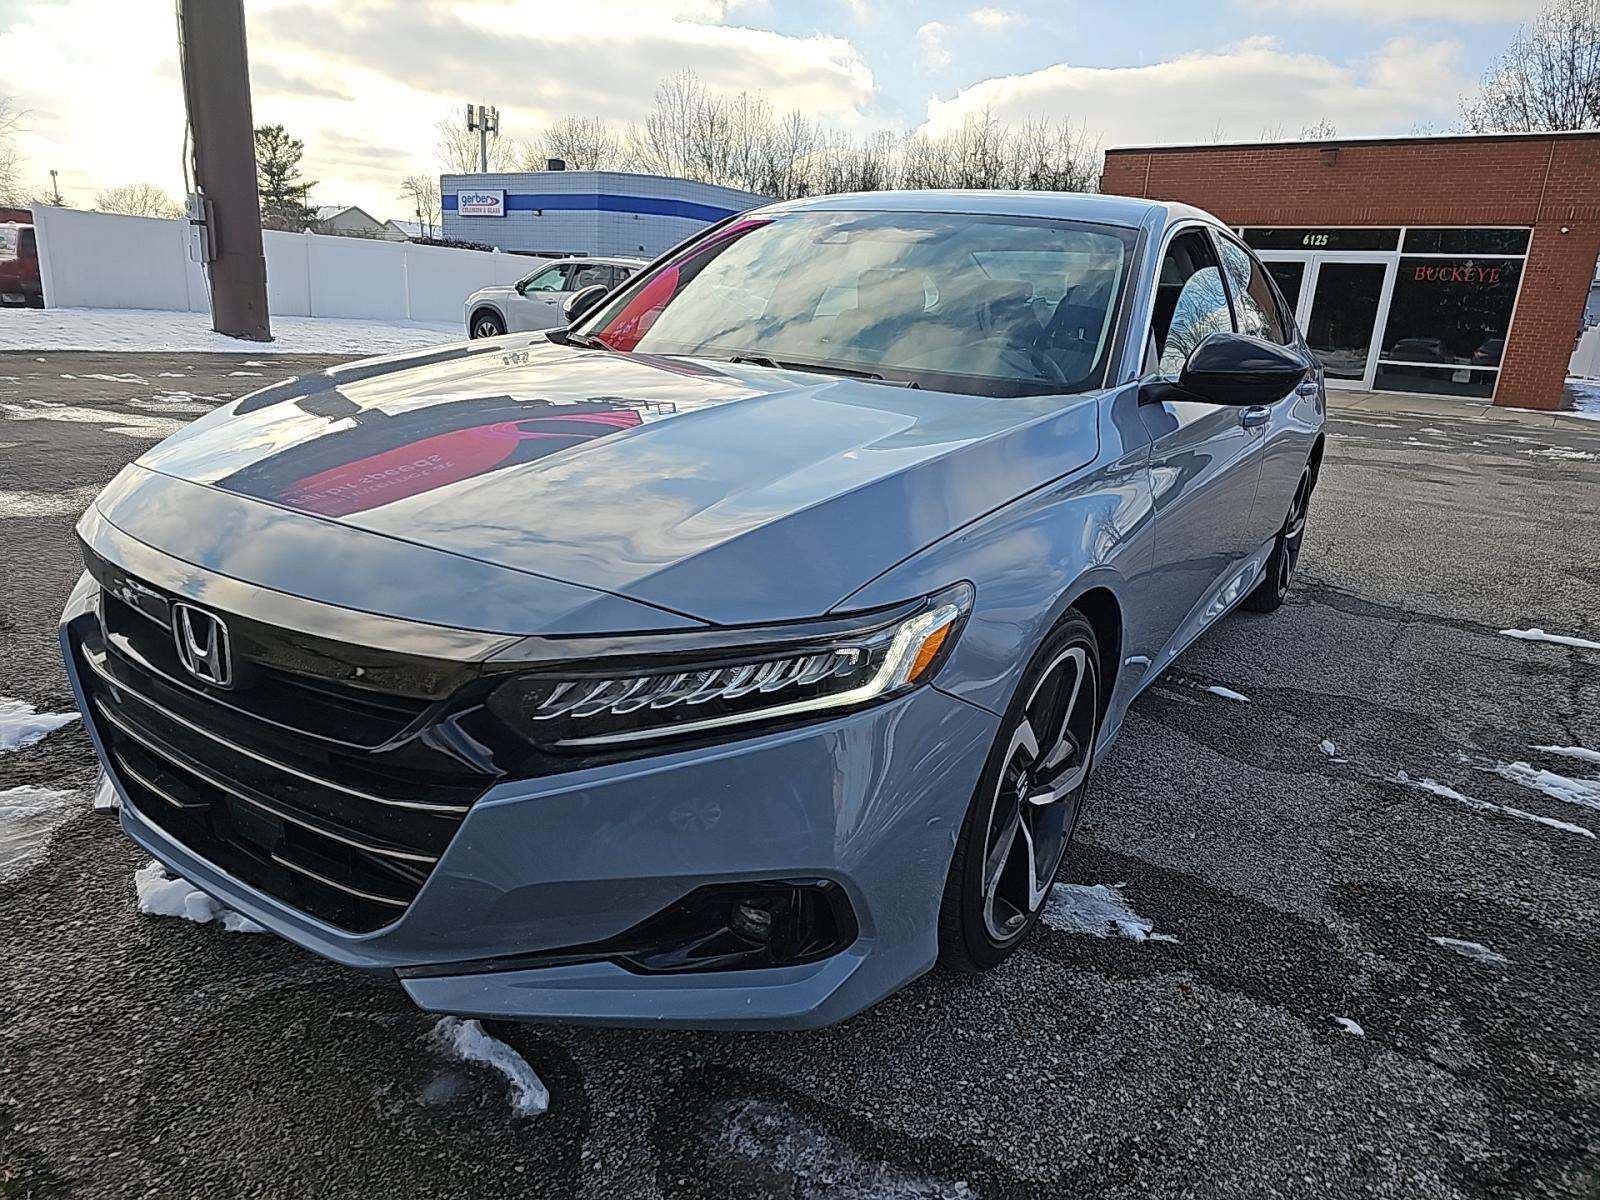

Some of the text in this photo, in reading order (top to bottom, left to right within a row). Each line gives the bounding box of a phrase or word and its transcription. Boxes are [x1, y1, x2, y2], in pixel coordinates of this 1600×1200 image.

[461, 192, 490, 207] gerber
[1302, 234, 1329, 246] 6125
[1414, 266, 1502, 284] BUCKEYE
